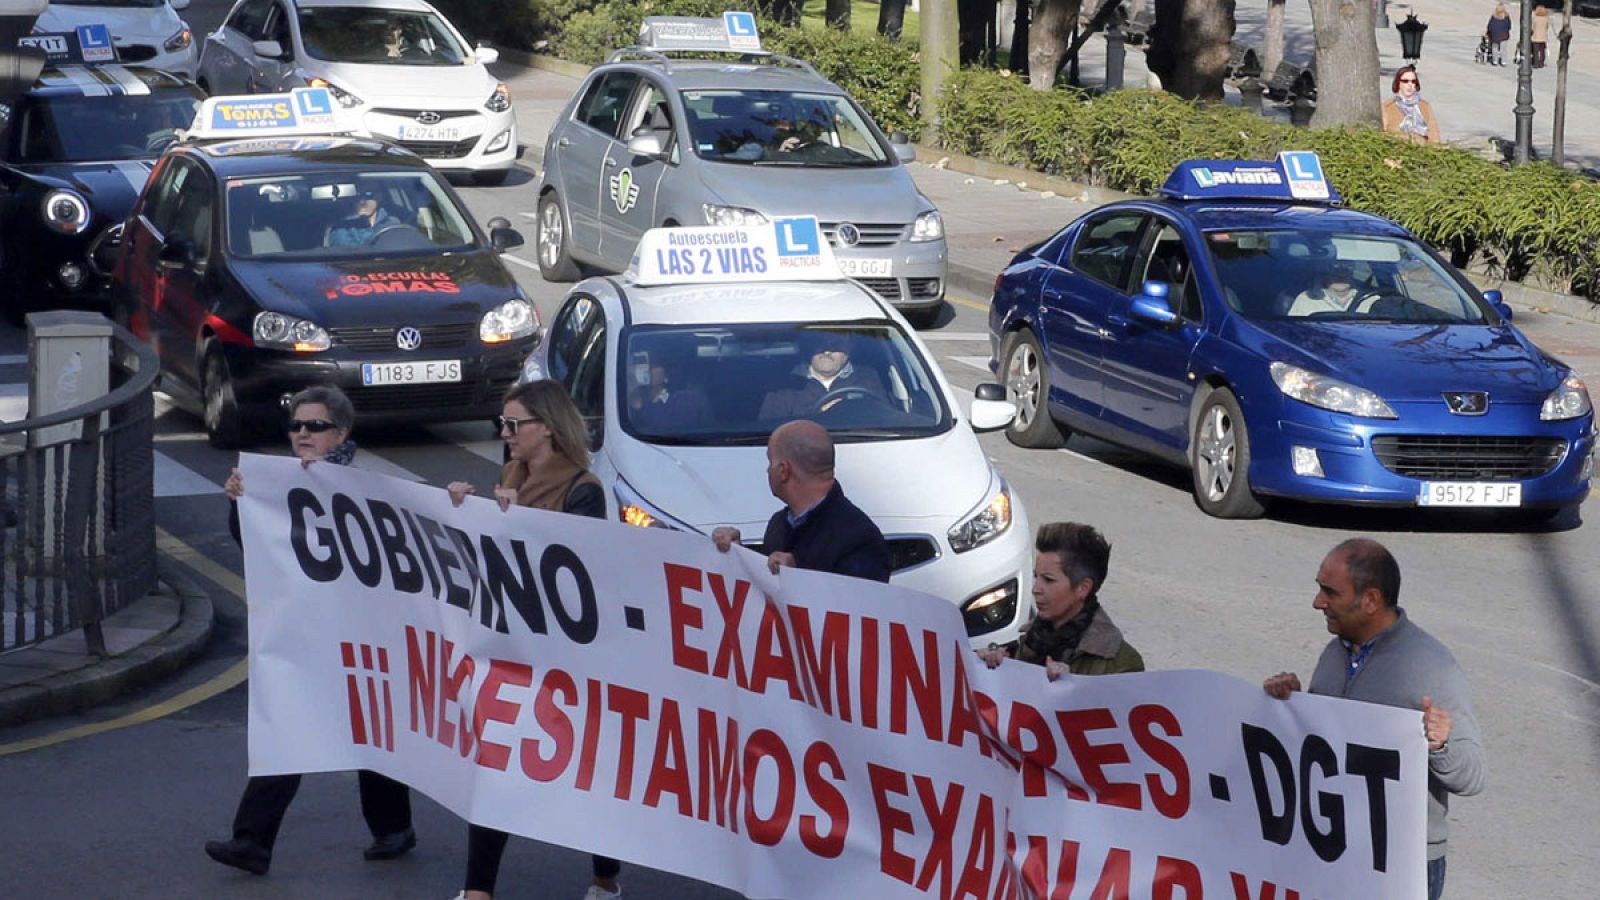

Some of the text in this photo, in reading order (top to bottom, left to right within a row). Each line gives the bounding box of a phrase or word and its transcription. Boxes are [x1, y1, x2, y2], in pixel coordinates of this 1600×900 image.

[733, 16, 749, 34] L
[85, 28, 103, 45] L
[217, 103, 290, 121] TOMAS
[303, 93, 324, 112] L
[406, 128, 459, 139] 4274 HTR
[1291, 156, 1313, 178] L
[1191, 168, 1283, 187] Laviana
[668, 230, 748, 246] Autoescuela
[783, 223, 808, 251] L
[656, 247, 767, 275] LAS 2 VIAS
[374, 363, 459, 382] 1183 FJS
[1435, 485, 1517, 503] 9512 FJF
[287, 487, 599, 645] GOBIERNO
[1241, 722, 1401, 873] DGT
[405, 624, 849, 859] NECESITAMOS
